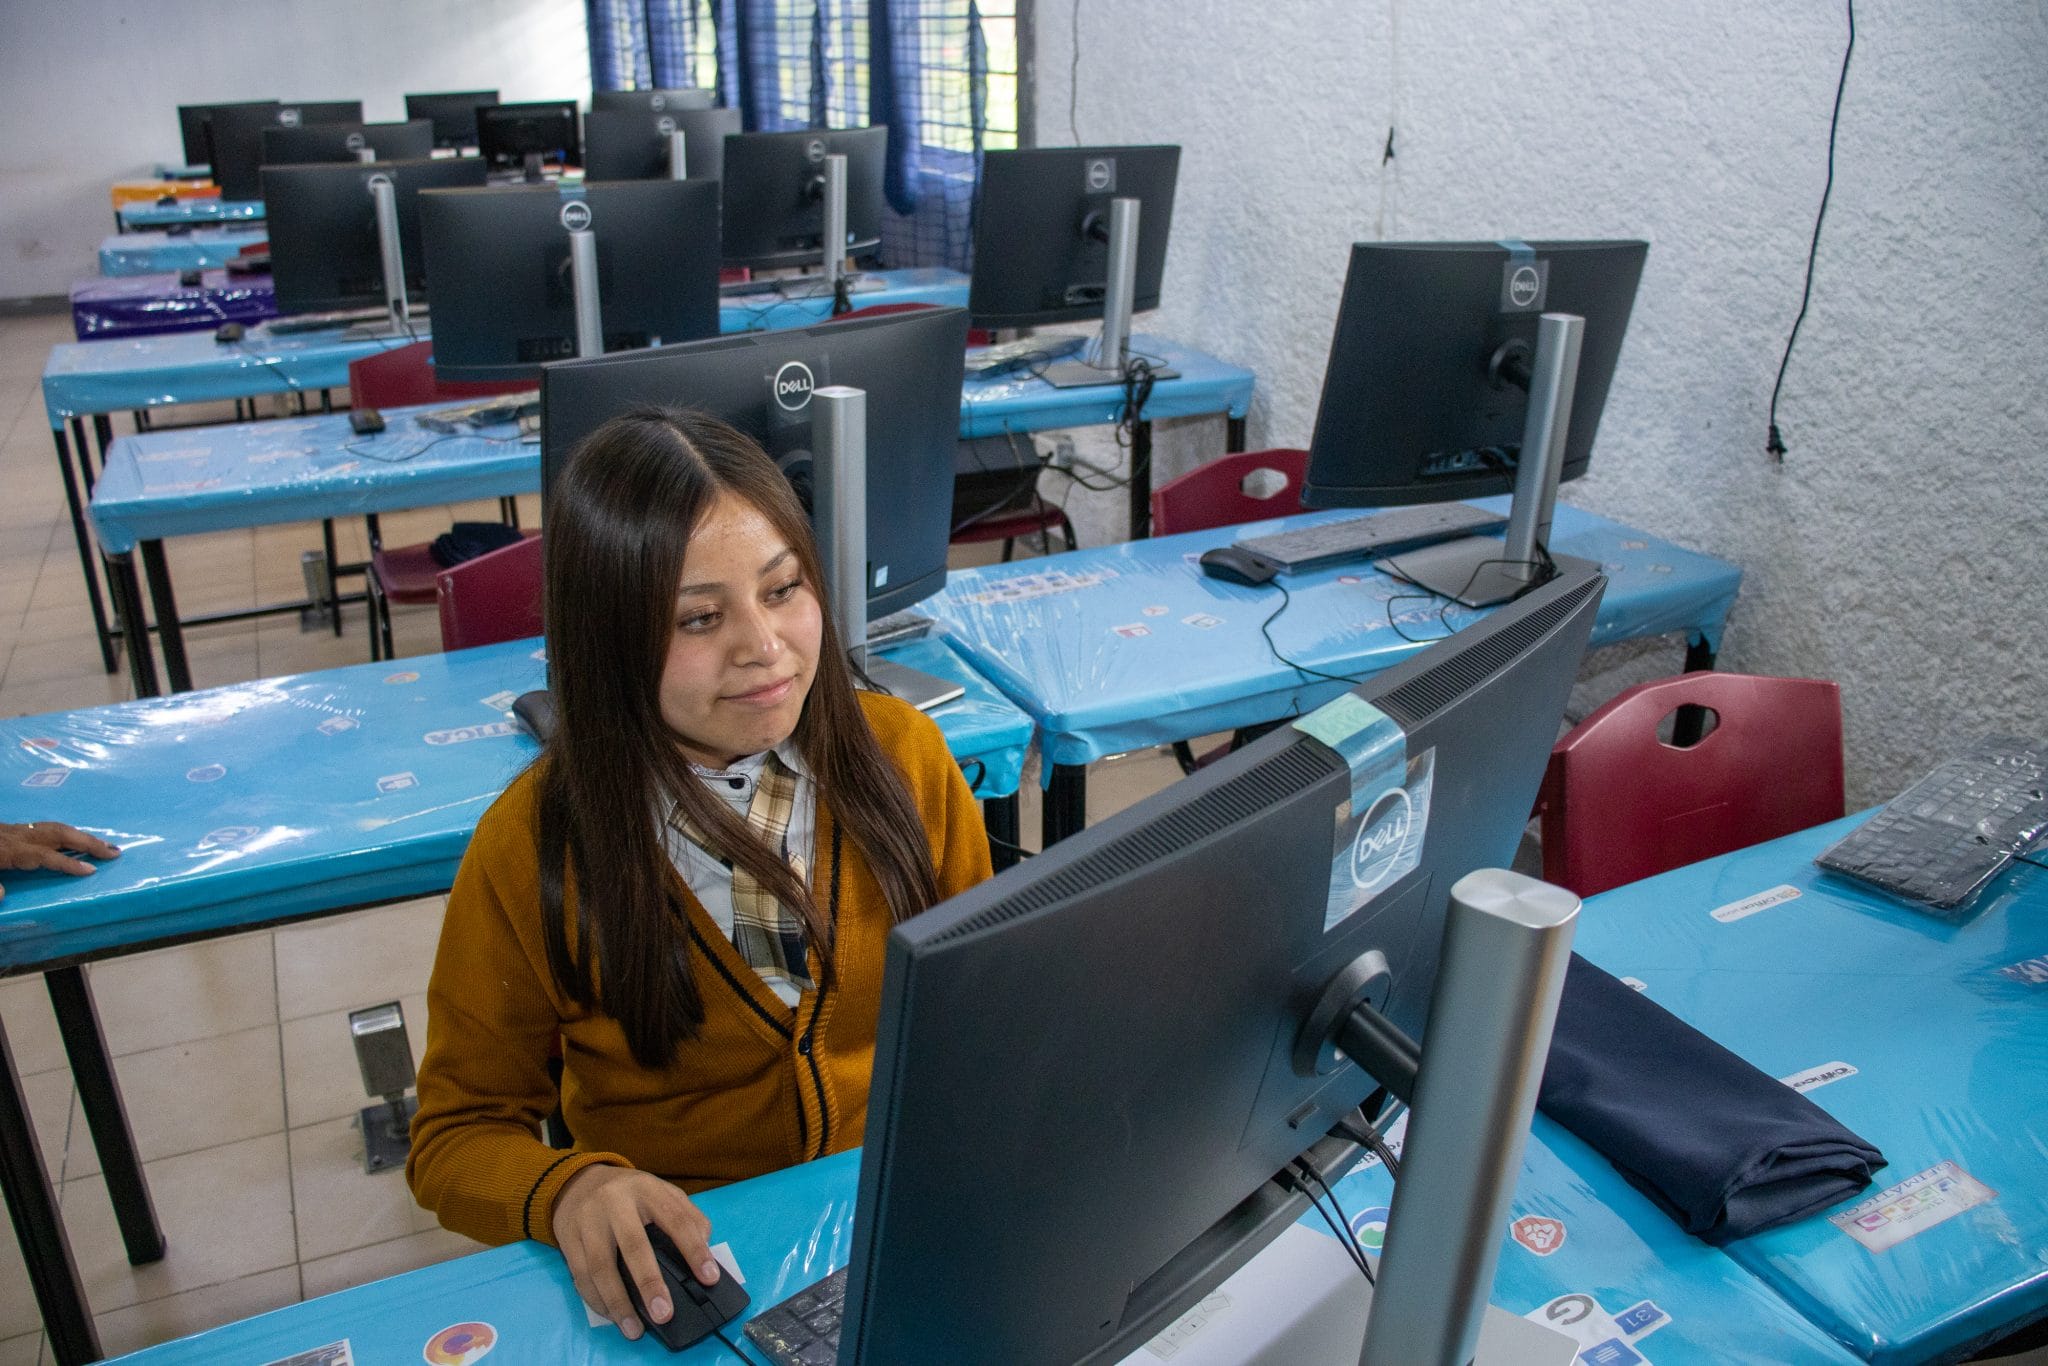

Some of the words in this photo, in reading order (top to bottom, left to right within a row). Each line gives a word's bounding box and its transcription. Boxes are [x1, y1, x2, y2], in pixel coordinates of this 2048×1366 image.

[779, 378, 811, 395] DELL
[1359, 816, 1405, 863] DELL
[1546, 1294, 1594, 1326] G
[1625, 1309, 1651, 1328] 31
